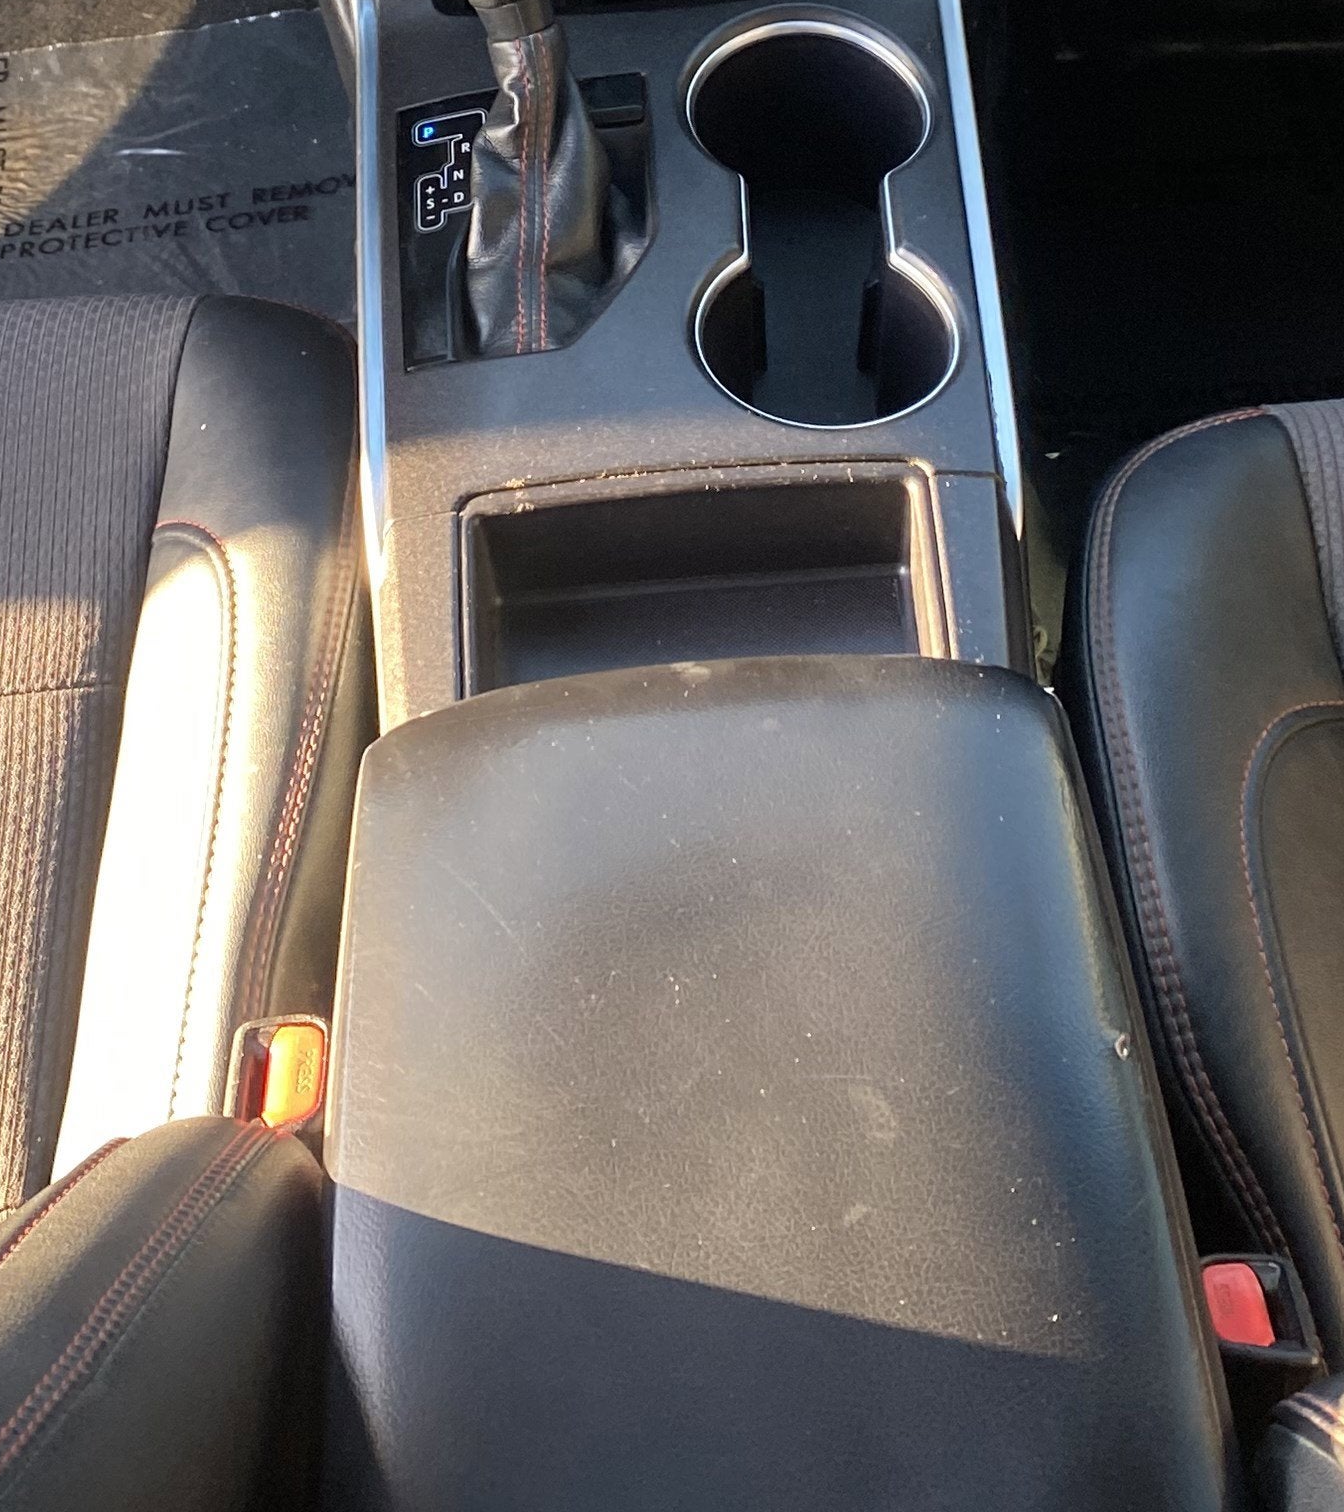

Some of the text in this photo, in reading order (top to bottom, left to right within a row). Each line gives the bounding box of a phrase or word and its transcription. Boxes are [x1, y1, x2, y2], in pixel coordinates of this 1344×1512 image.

[422, 125, 434, 138] P
[461, 141, 471, 153] R
[453, 169, 464, 180] N
[426, 192, 464, 209] S D
[3, 208, 120, 238] DEALER
[142, 191, 232, 220] MUST
[0, 204, 312, 261] PROTECTIVE COVER
